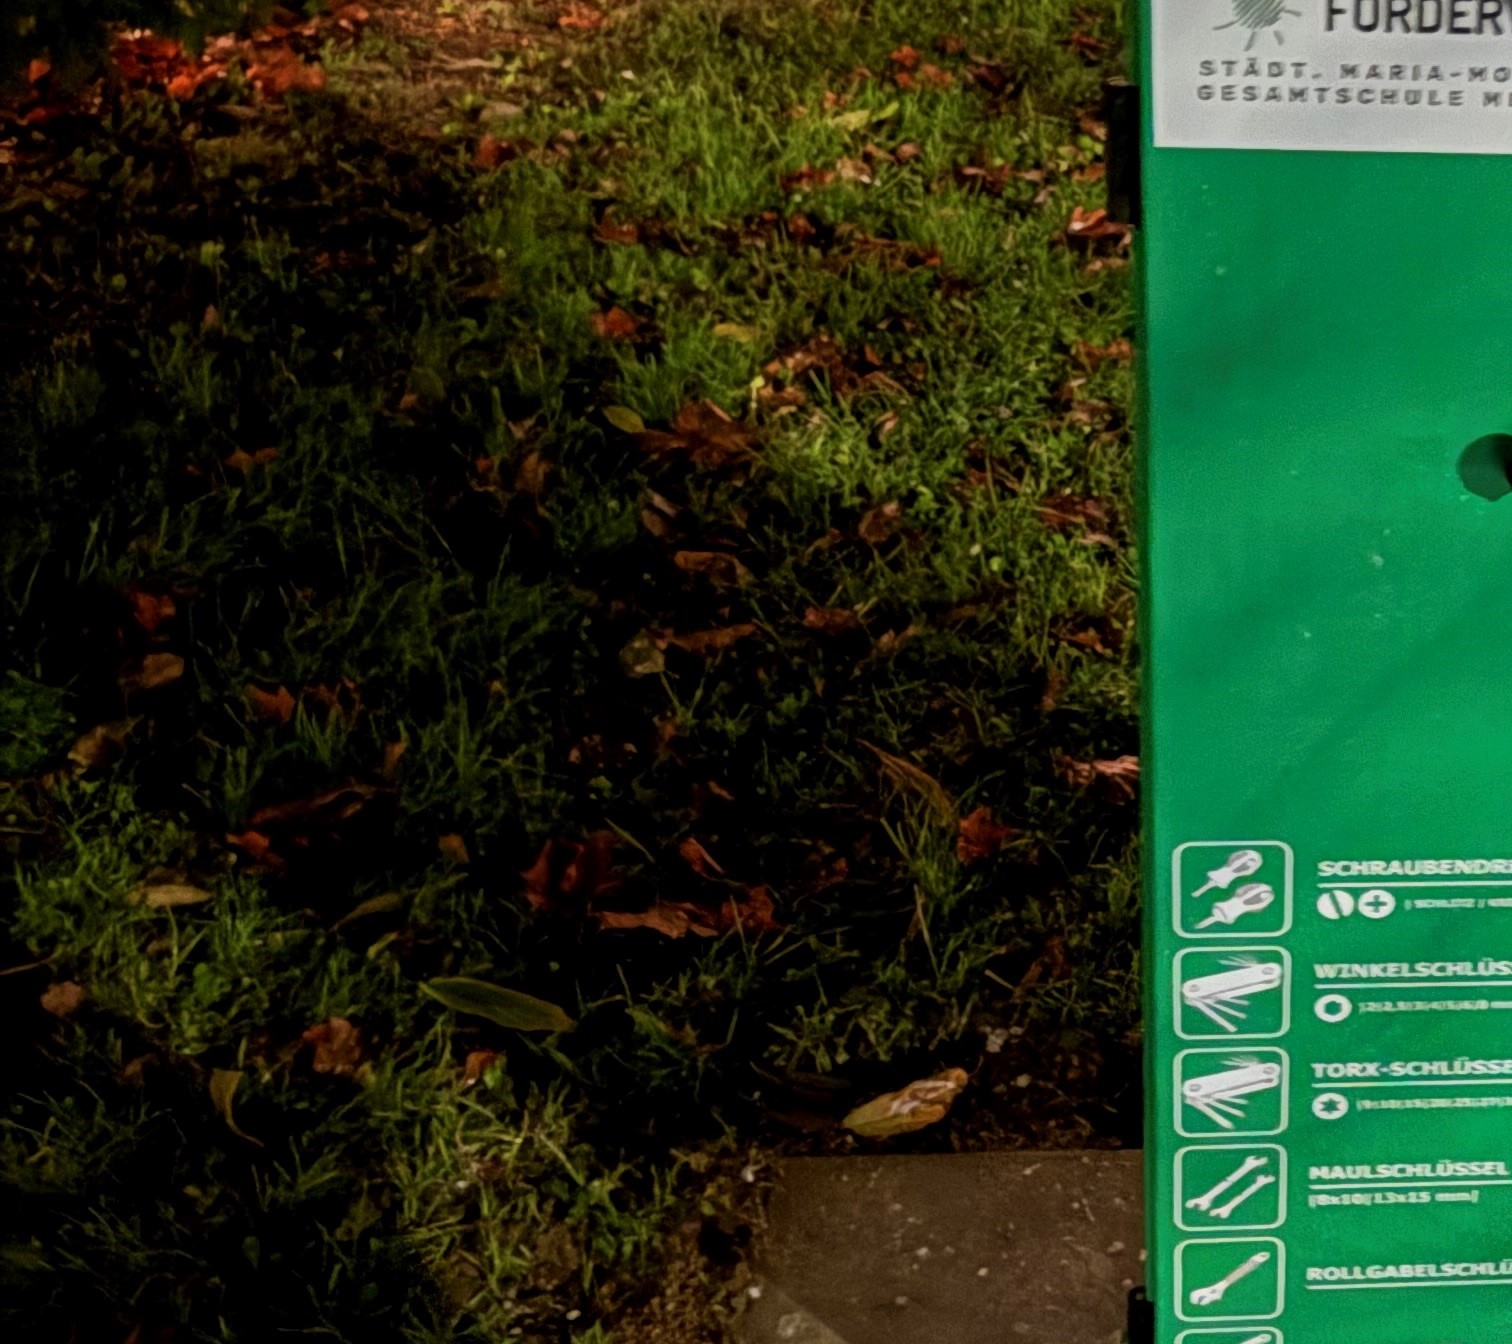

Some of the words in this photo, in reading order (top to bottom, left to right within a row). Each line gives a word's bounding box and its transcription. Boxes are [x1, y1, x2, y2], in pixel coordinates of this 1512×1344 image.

[1198, 57, 1323, 80] STÄDT.
[1196, 84, 1465, 108] GESAMTSCHULE
[1309, 1159, 1510, 1180] MAULSCHLÜSSEL
